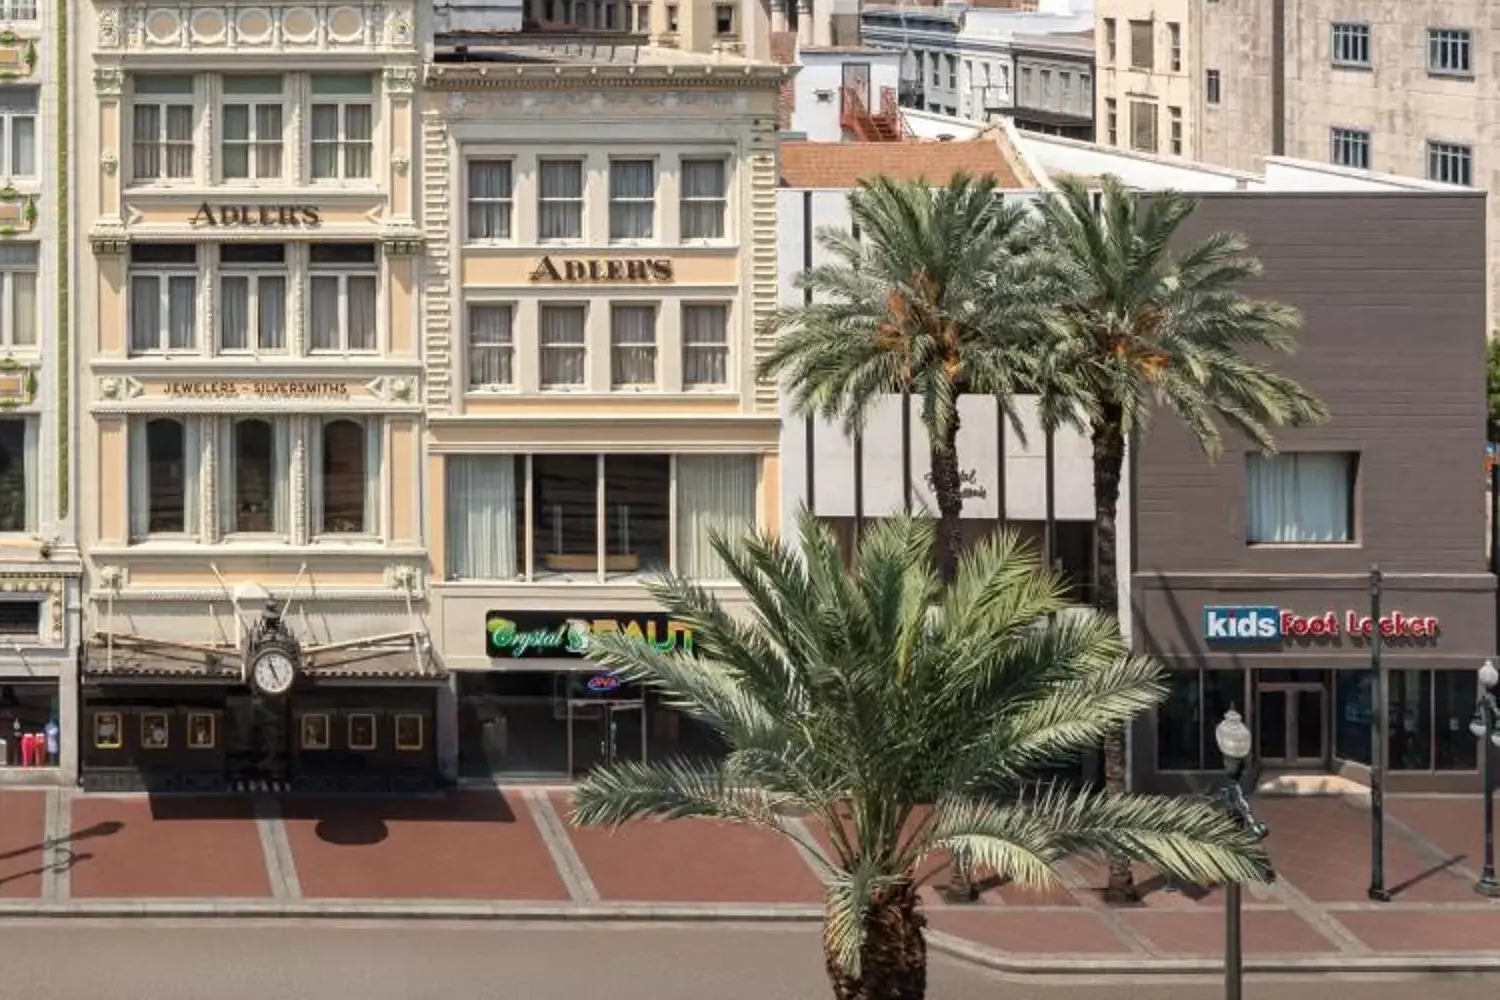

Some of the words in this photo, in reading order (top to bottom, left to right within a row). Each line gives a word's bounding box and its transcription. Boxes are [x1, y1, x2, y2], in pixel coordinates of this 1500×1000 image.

[529, 255, 674, 281] ADLER'S
[163, 381, 237, 395] JEWELERS
[253, 381, 348, 395] SILVERSMITHS
[1207, 610, 1277, 637] kids
[1279, 609, 1338, 635] Foot
[1345, 609, 1439, 635] Locker
